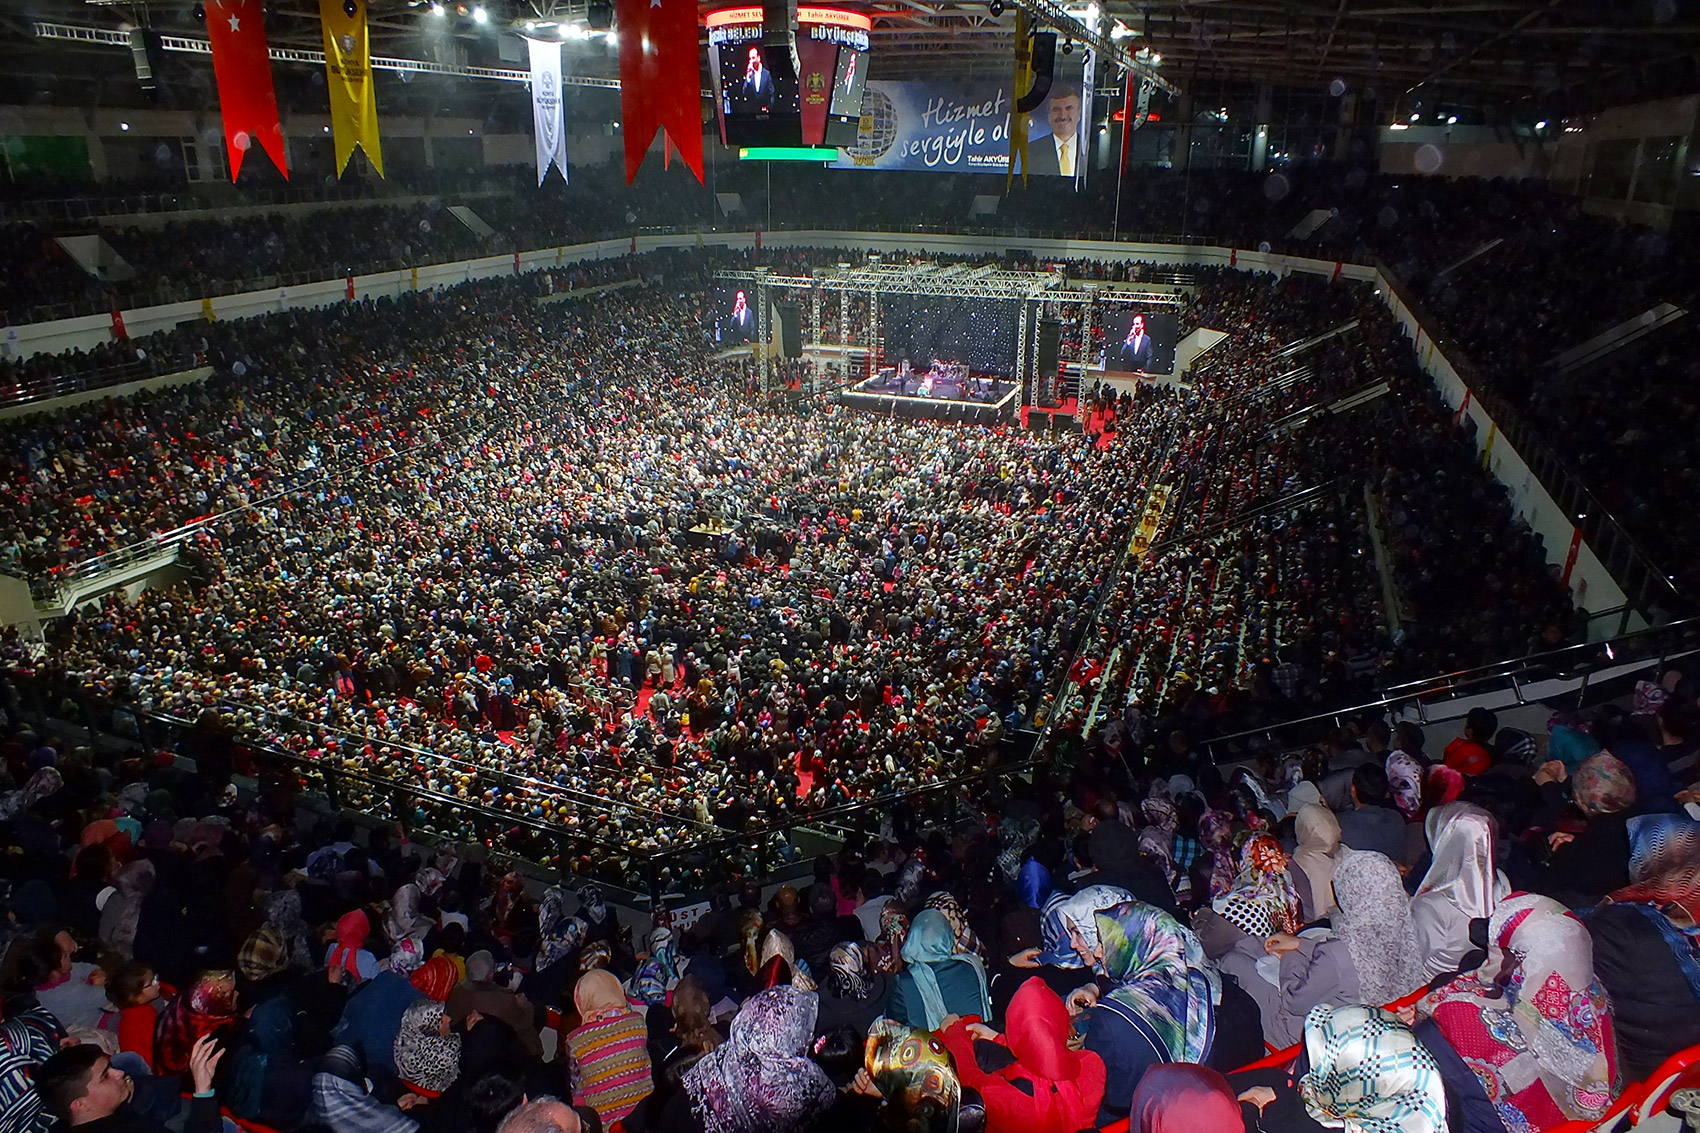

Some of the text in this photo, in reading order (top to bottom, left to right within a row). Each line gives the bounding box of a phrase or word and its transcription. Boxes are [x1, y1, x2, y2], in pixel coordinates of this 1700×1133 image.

[921, 88, 1005, 128] Hizmet
[900, 119, 985, 167] sergiyle
[967, 154, 984, 163] Tahir
